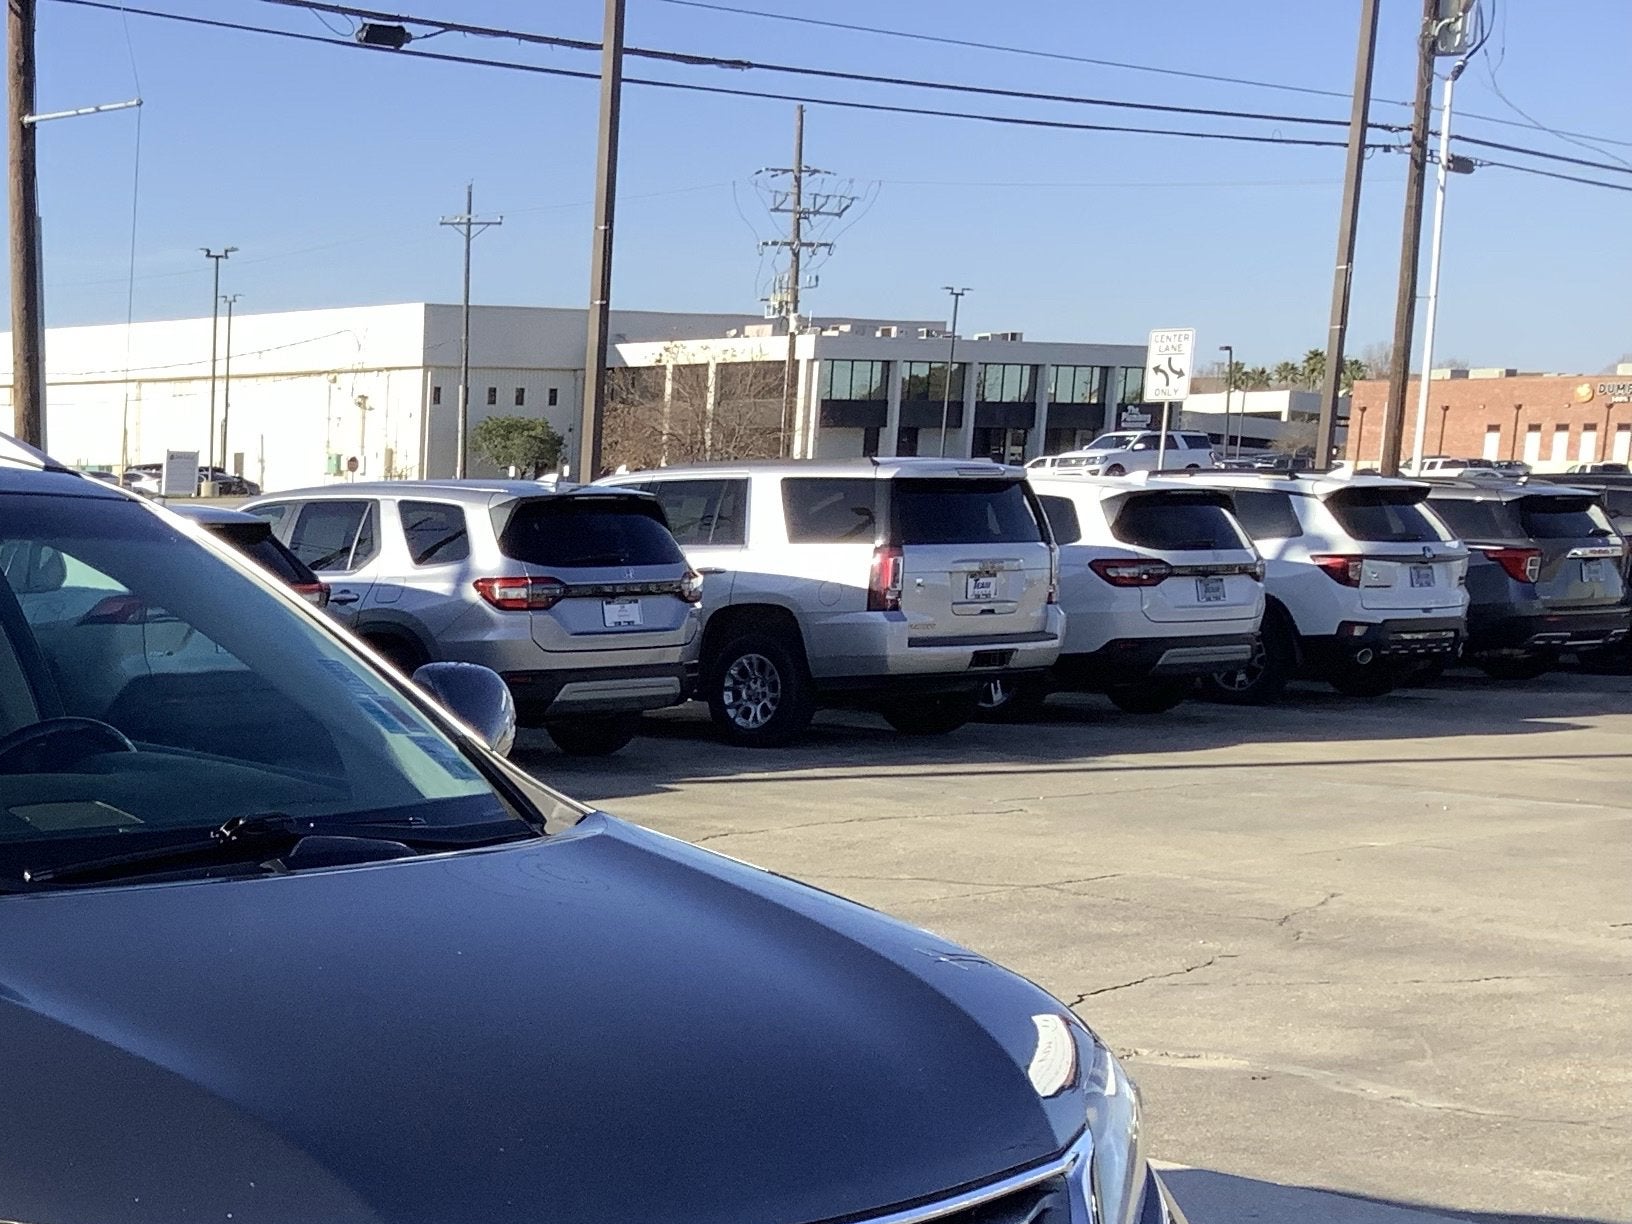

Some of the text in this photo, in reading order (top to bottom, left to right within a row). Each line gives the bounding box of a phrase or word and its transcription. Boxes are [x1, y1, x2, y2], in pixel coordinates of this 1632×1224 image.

[1154, 334, 1190, 343] CENTER
[1159, 344, 1183, 352] LANE
[1154, 388, 1179, 396] ONLY
